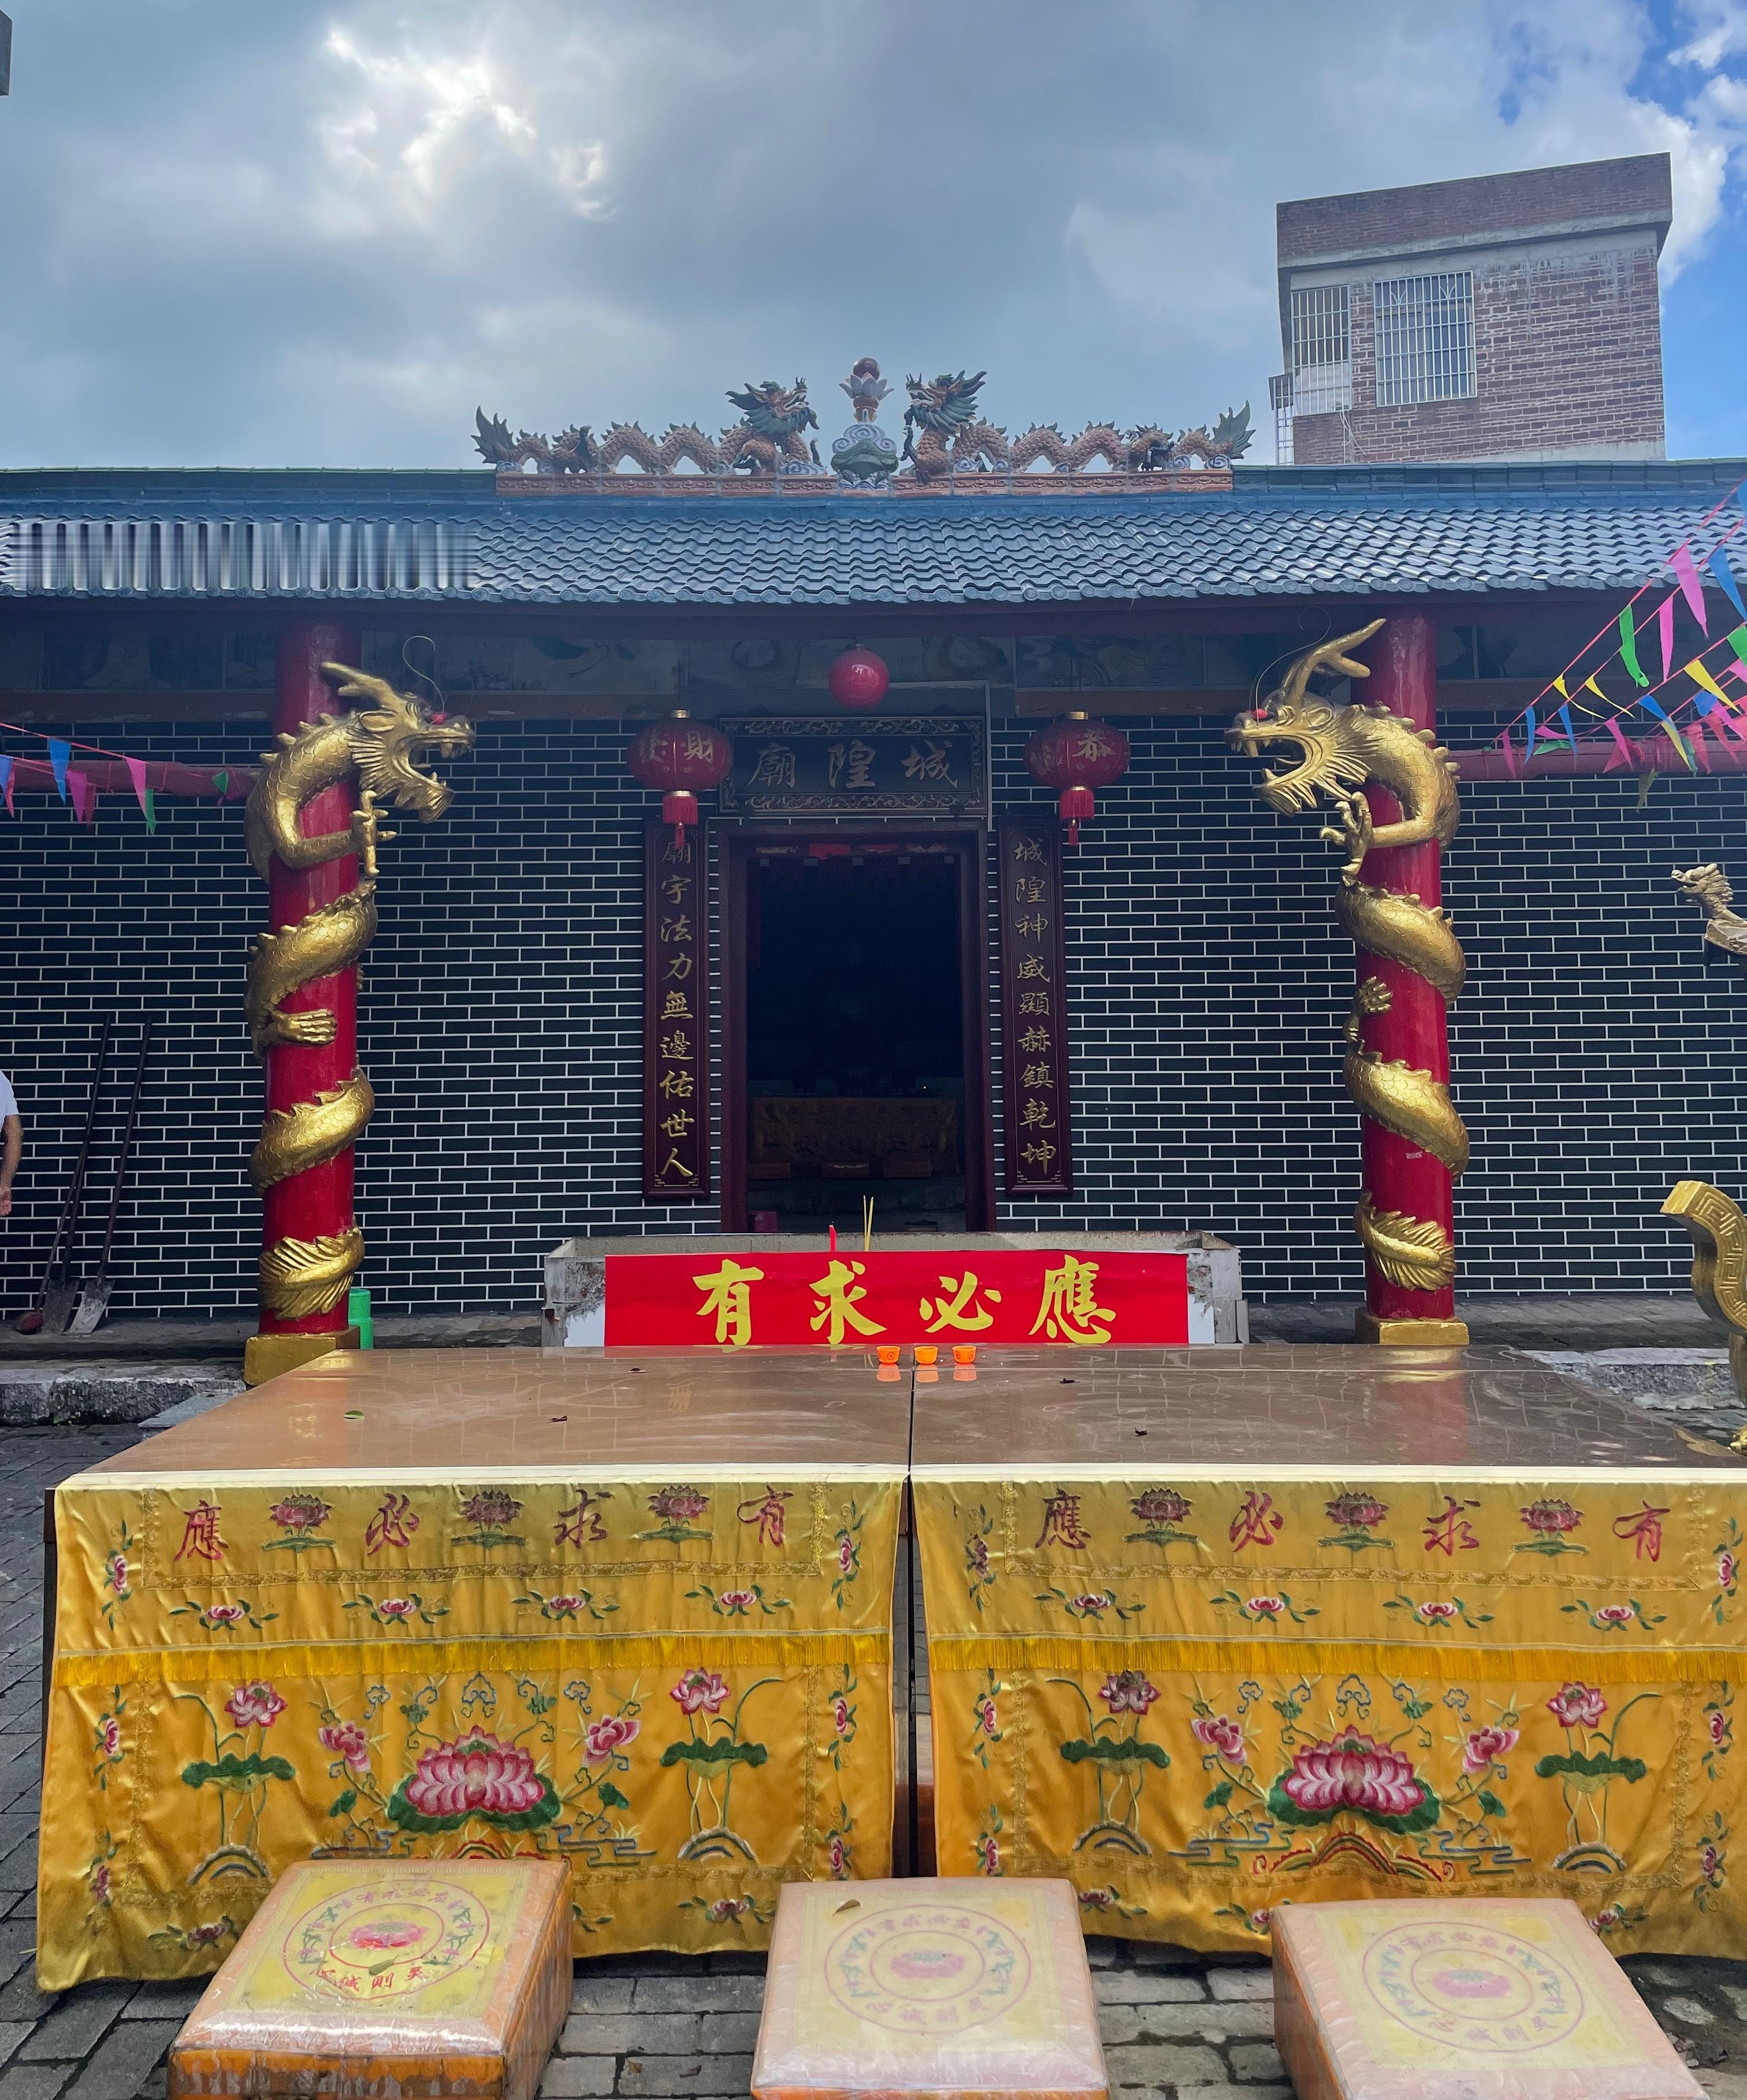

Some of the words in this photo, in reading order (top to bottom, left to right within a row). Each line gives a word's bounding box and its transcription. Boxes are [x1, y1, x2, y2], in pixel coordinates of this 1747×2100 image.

[748, 739, 959, 790] 城隍廟
[1012, 837, 1056, 1175] 城隍神威顯赫鎮乾坤
[693, 1254, 1117, 1345] 有求必應
